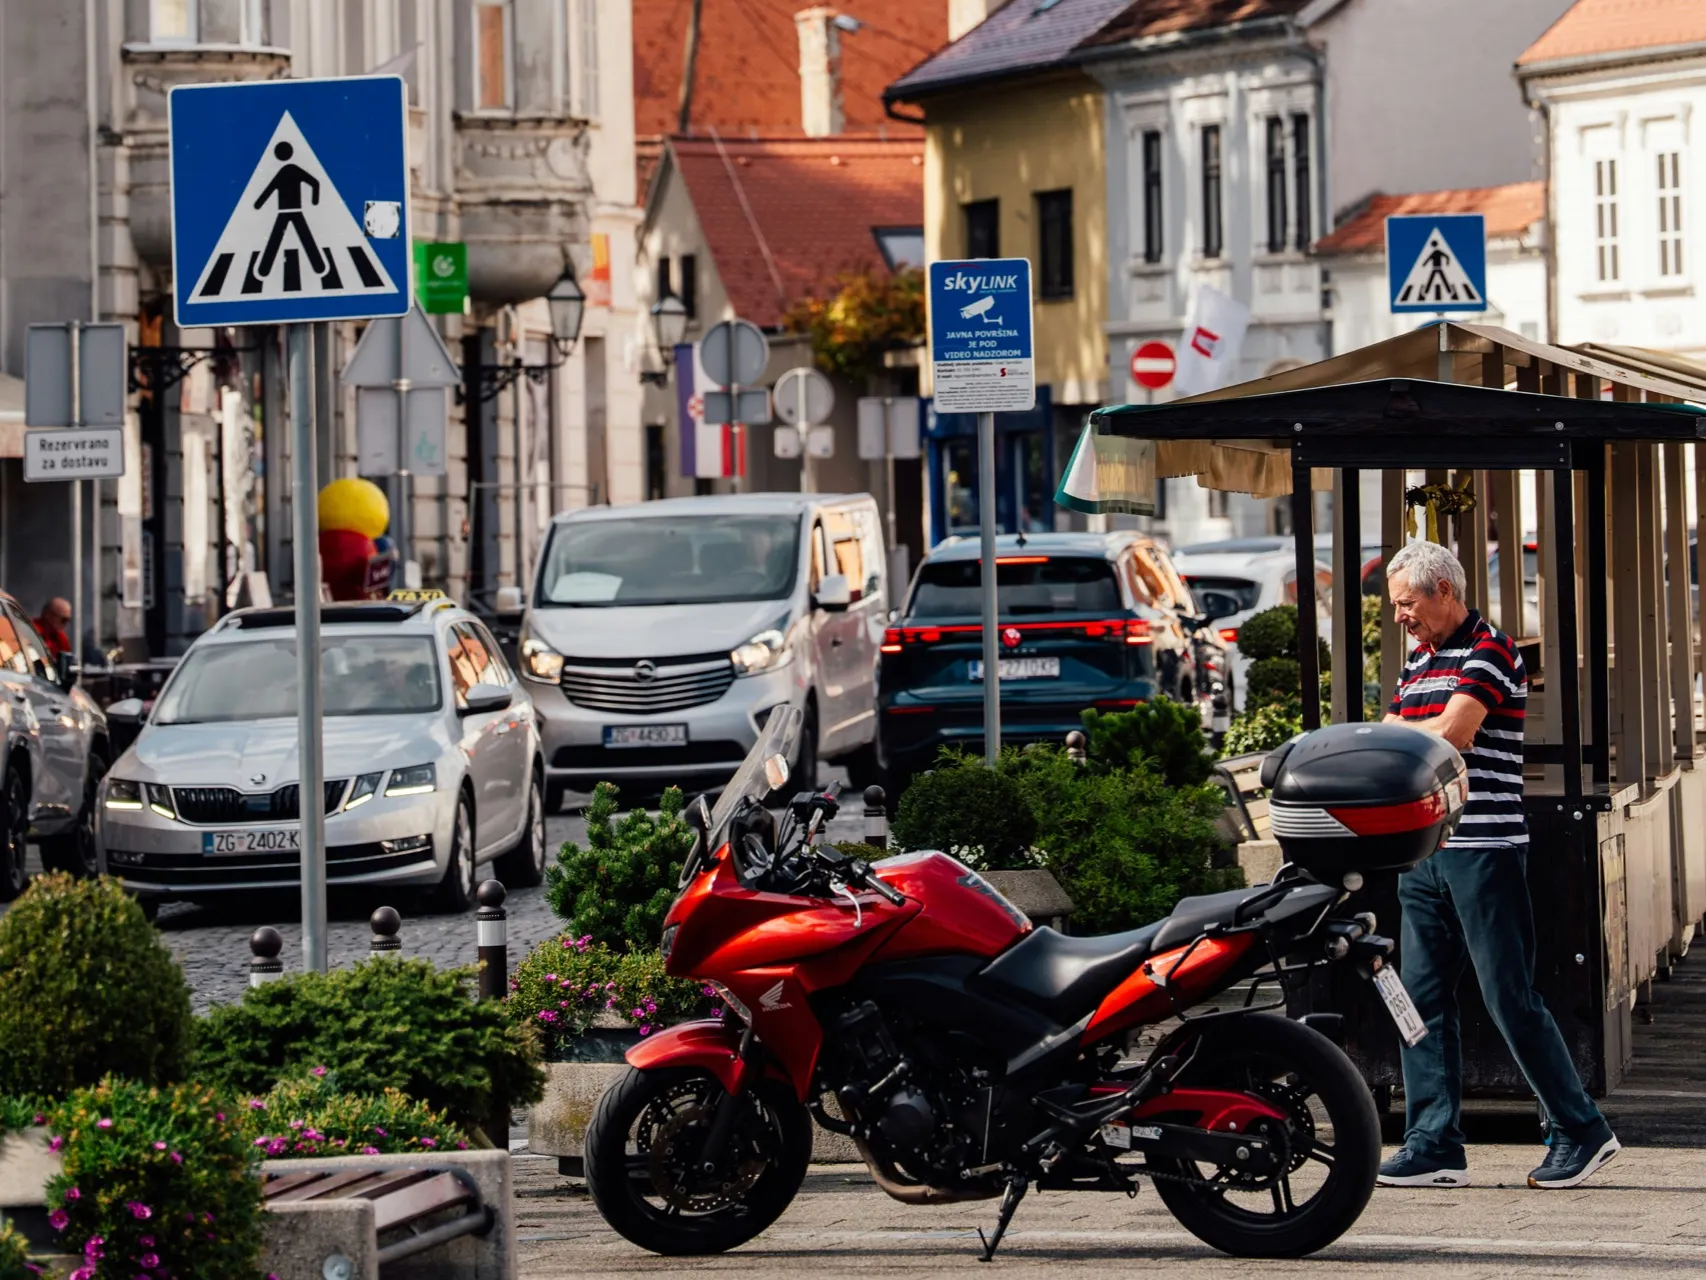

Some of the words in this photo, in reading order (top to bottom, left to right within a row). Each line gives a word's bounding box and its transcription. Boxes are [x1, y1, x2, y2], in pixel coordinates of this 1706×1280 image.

[946, 331, 973, 339] JAVNA
[975, 328, 1019, 338] POVRŠINA
[979, 340, 997, 348] POD
[944, 351, 971, 359] VIDEO
[973, 350, 1021, 358] NADZOROM
[39, 438, 109, 451] Rezervirano
[42, 459, 55, 470] za
[61, 456, 108, 469] dostavu
[394, 590, 441, 601] TAXI
[216, 834, 235, 852] ZG
[246, 831, 299, 850] 2402-K
[761, 1002, 793, 1012] HONDA
[1389, 991, 1410, 1018] 2651
[1403, 1012, 1417, 1033] AJ
